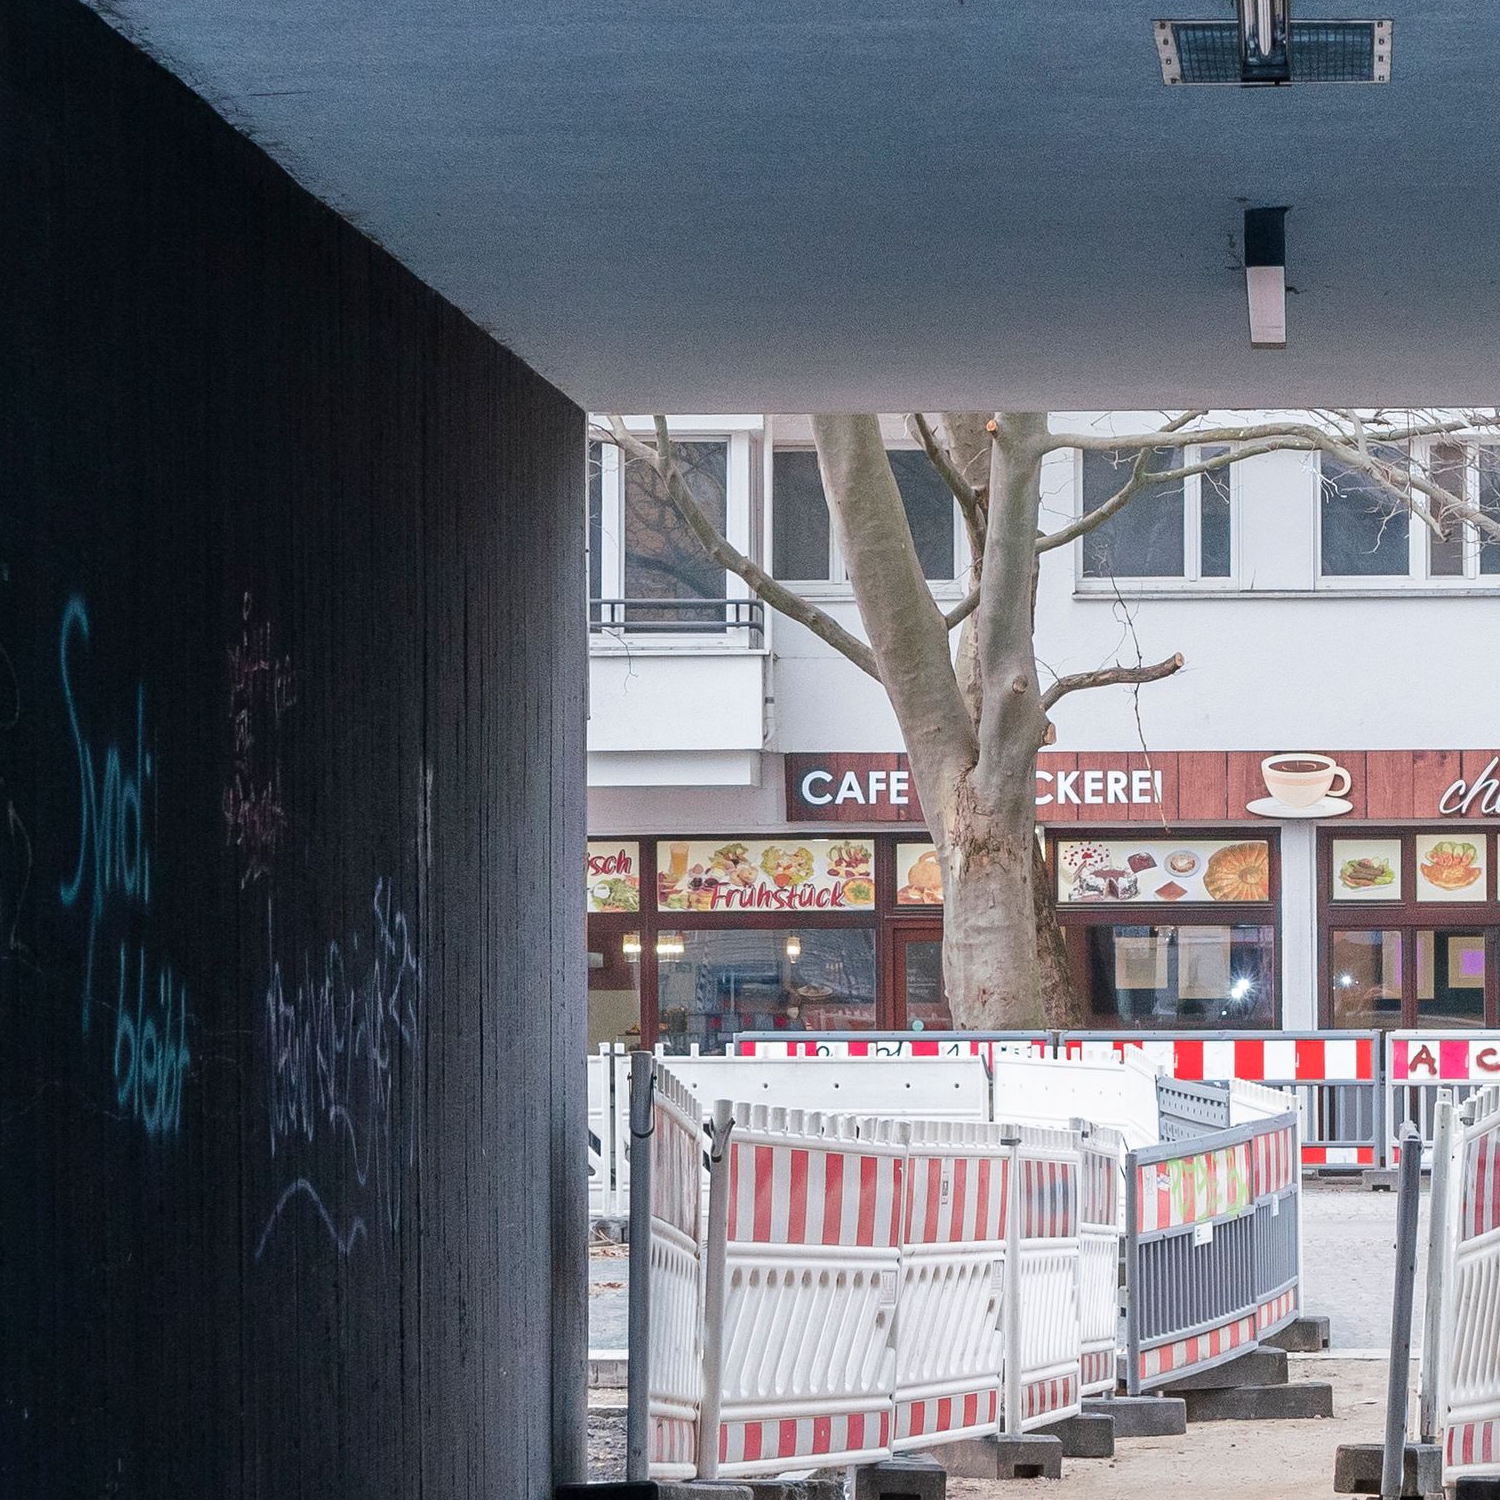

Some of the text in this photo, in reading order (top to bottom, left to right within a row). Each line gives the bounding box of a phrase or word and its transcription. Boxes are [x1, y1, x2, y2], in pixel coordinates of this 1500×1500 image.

[802, 770, 1163, 805] CAFE CKEREI
[710, 881, 845, 910] Frühstück
